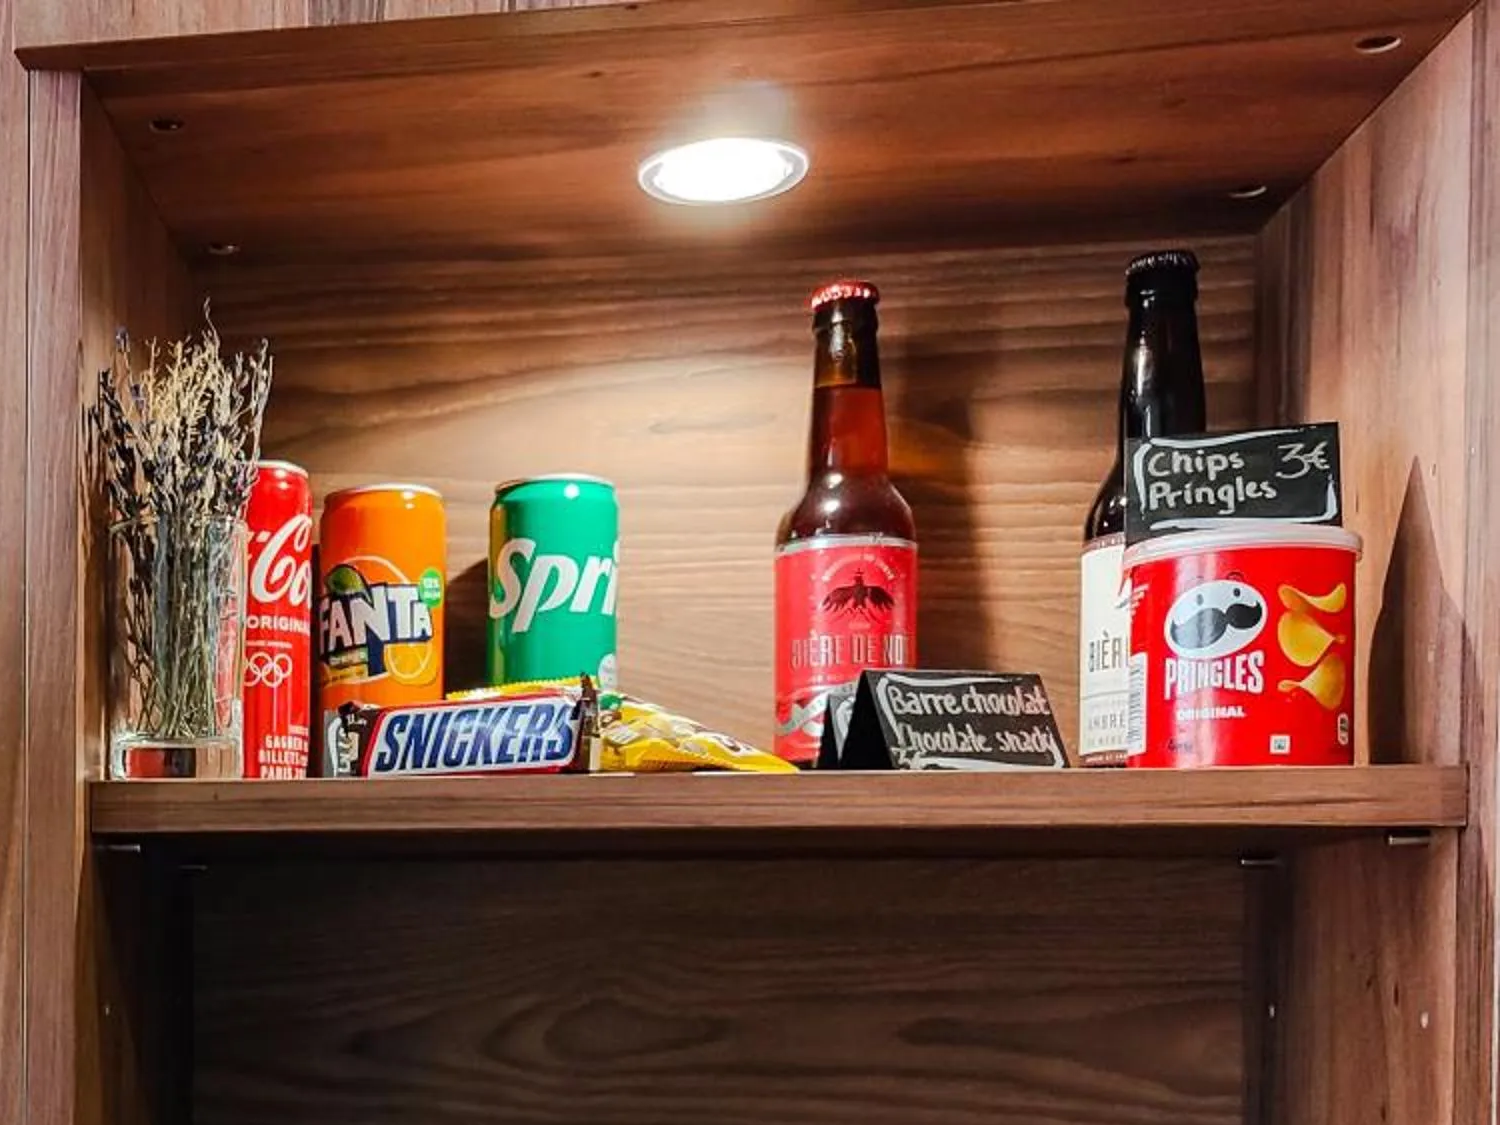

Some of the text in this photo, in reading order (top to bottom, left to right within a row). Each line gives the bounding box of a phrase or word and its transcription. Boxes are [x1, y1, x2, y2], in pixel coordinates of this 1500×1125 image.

[1150, 449, 1245, 481] Chips
[1150, 476, 1277, 515] Pringles
[489, 537, 619, 634] Spri
[1164, 650, 1265, 700] PRINGLES
[887, 684, 962, 715] Barre
[373, 702, 574, 773] SNICKERS
